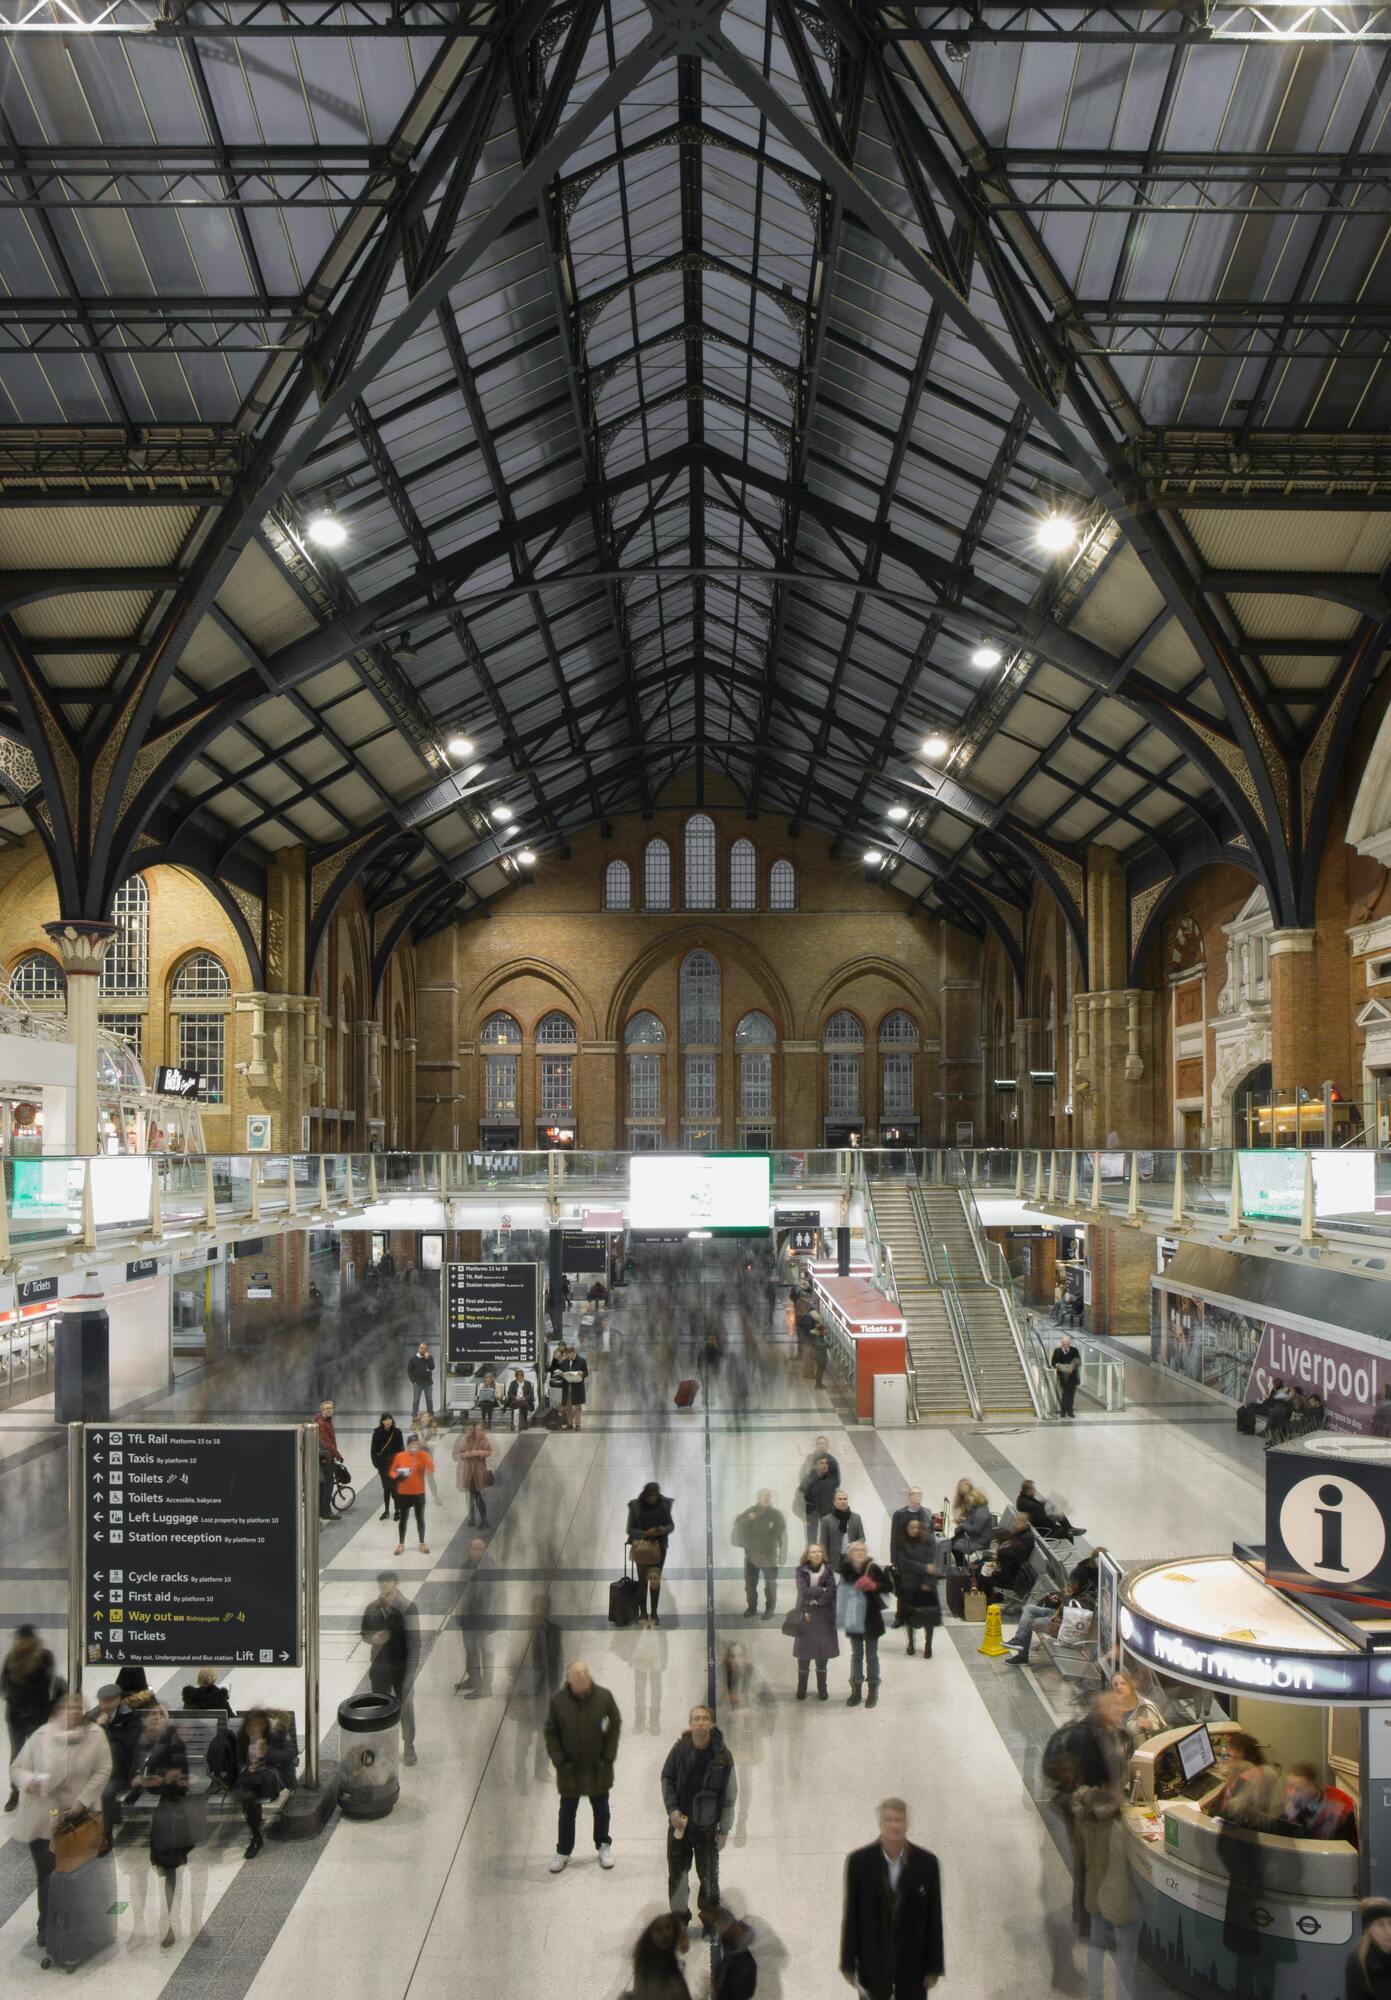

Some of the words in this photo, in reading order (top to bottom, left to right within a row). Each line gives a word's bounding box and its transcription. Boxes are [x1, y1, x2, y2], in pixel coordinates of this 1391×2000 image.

[32, 1280, 51, 1292] Tickets
[860, 1325, 888, 1333] Tickets
[1270, 1328, 1377, 1408] Liverpool
[128, 1434, 145, 1444] TfL
[148, 1434, 168, 1444] Rail
[128, 1453, 154, 1463] Taxis
[128, 1473, 163, 1483] Toilets
[128, 1492, 163, 1503] Toilets
[128, 1512, 150, 1522] Left
[153, 1512, 198, 1525] Luggage
[1314, 1483, 1349, 1573] i
[128, 1532, 168, 1542] Station
[171, 1532, 222, 1544] reception
[128, 1572, 158, 1584] Cycle
[161, 1572, 188, 1582] racks
[128, 1591, 152, 1601] First
[154, 1592, 170, 1601] aid
[128, 1611, 151, 1623] Way
[154, 1613, 172, 1621] out
[128, 1630, 166, 1640] Tickets
[236, 1651, 254, 1661] Lift
[1154, 1630, 1314, 1690] Information
